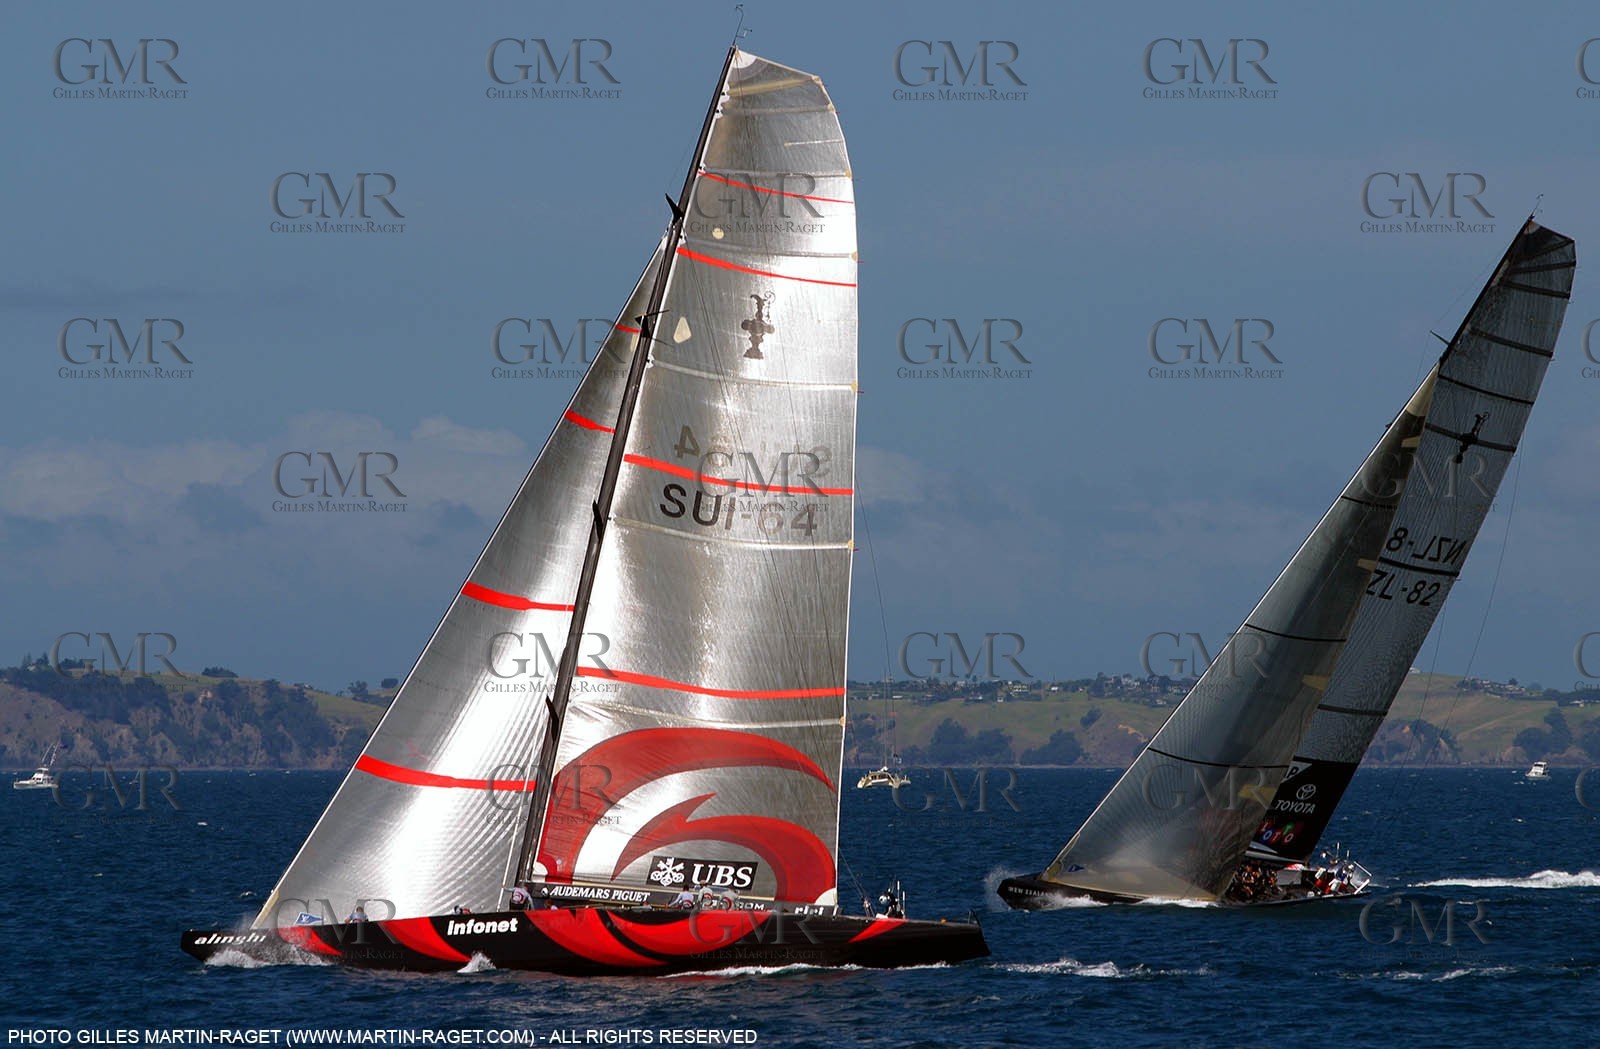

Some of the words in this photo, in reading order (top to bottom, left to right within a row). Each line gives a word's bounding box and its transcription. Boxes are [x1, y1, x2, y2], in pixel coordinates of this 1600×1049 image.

[660, 483, 817, 536] SUI-64
[1275, 799, 1316, 814] TOYOTA
[691, 863, 753, 888] UBS
[550, 886, 610, 900] AUDEMARS
[611, 890, 651, 902] PIGUET
[447, 917, 519, 936] Infonet
[194, 932, 267, 945] alinghi
